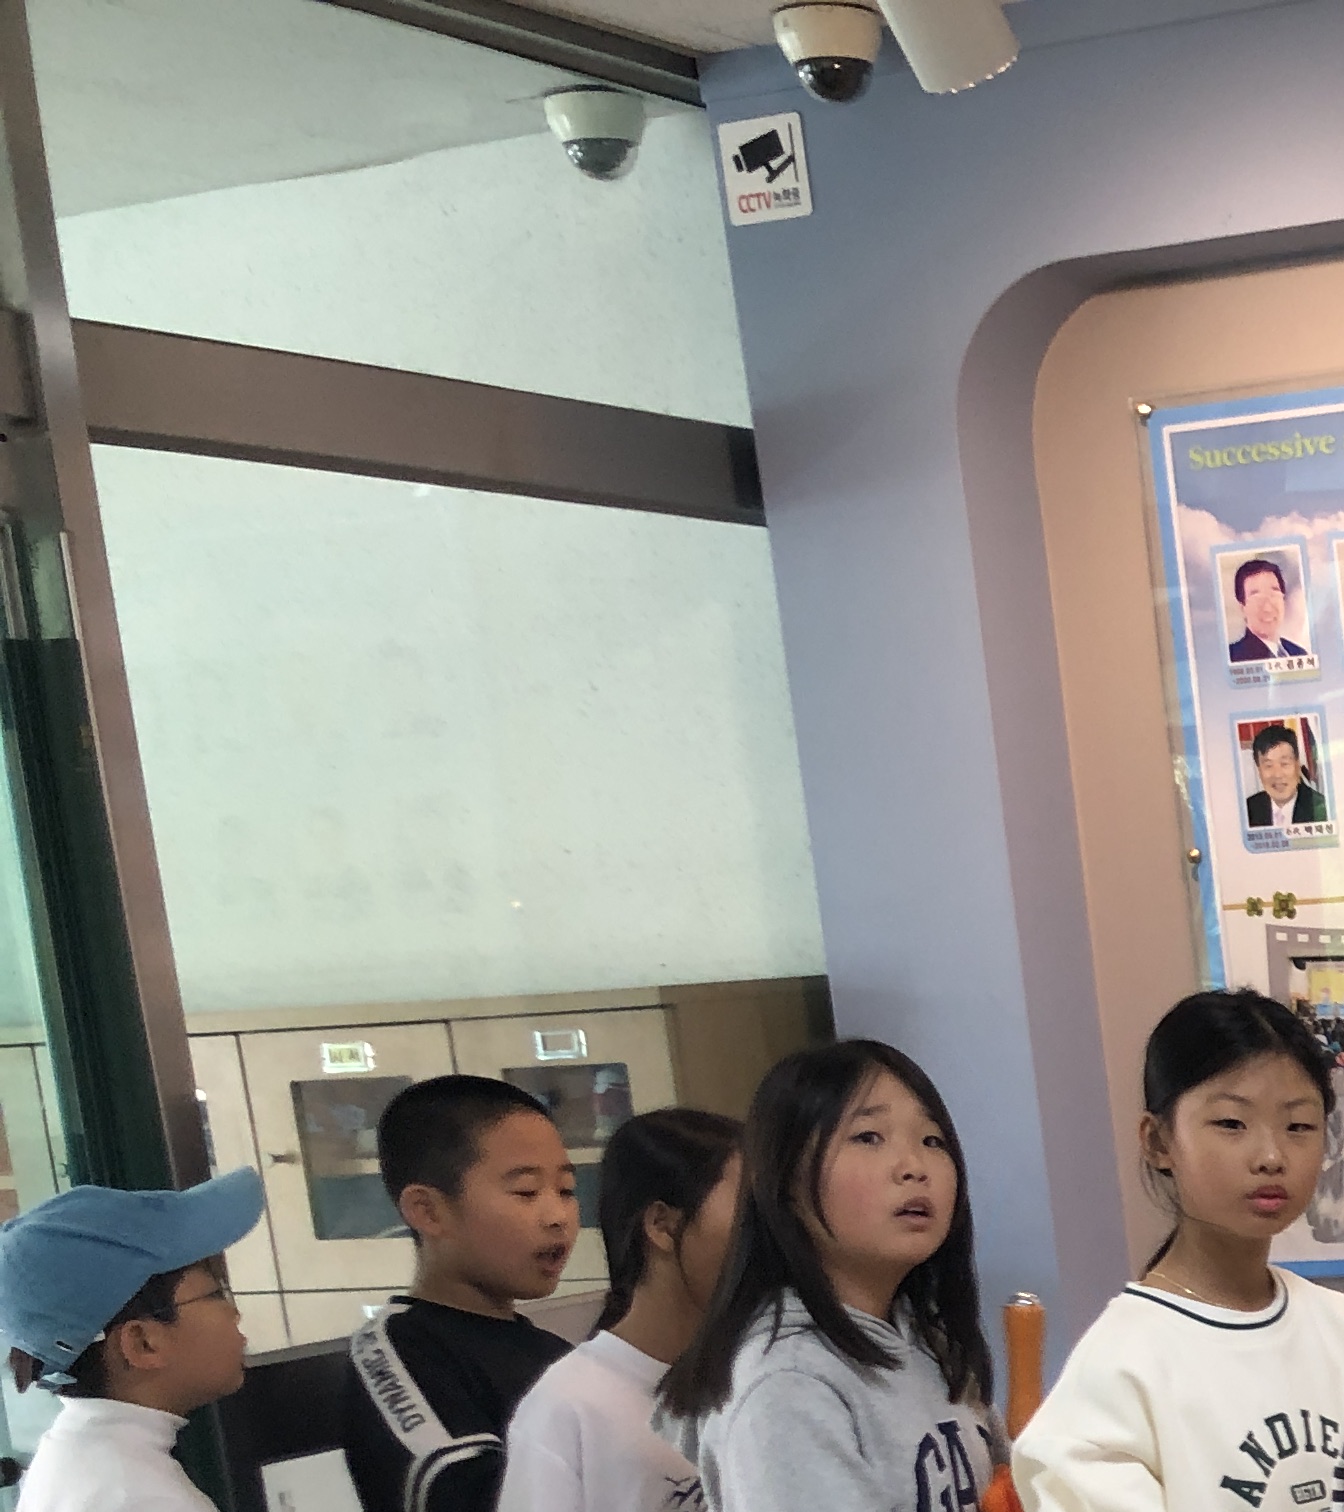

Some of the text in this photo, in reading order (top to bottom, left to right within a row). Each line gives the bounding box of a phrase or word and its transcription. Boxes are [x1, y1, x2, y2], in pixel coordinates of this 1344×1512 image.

[738, 191, 772, 213] CCTV
[1188, 427, 1337, 470] Successive
[360, 1349, 426, 1434] DYNAMIC
